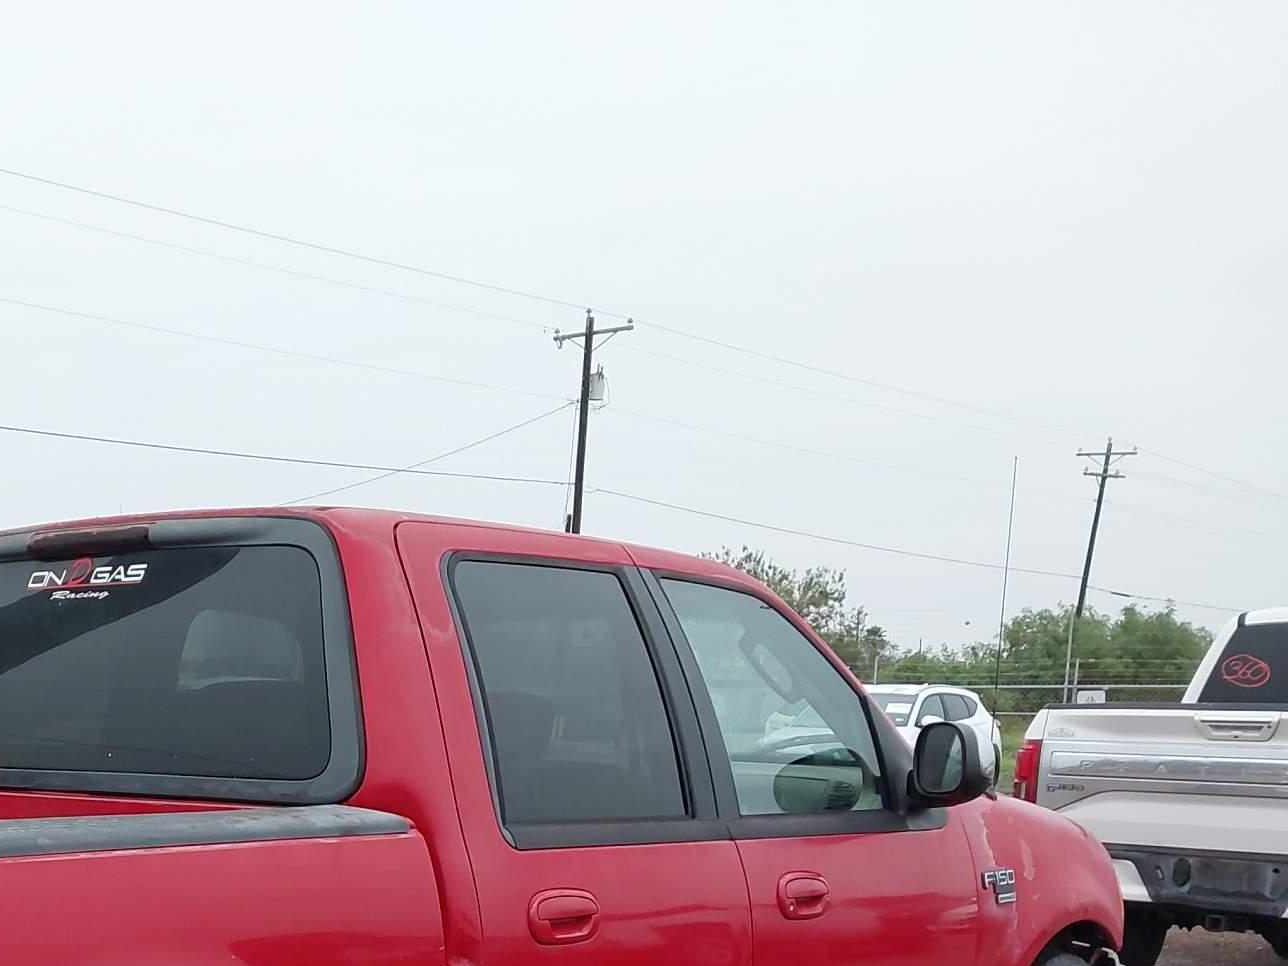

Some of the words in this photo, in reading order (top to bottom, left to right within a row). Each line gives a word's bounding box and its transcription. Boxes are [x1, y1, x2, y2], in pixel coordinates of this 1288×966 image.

[27, 569, 67, 588] ON
[90, 563, 149, 584] GAS
[49, 590, 110, 600] Racing
[1225, 660, 1268, 680] 360
